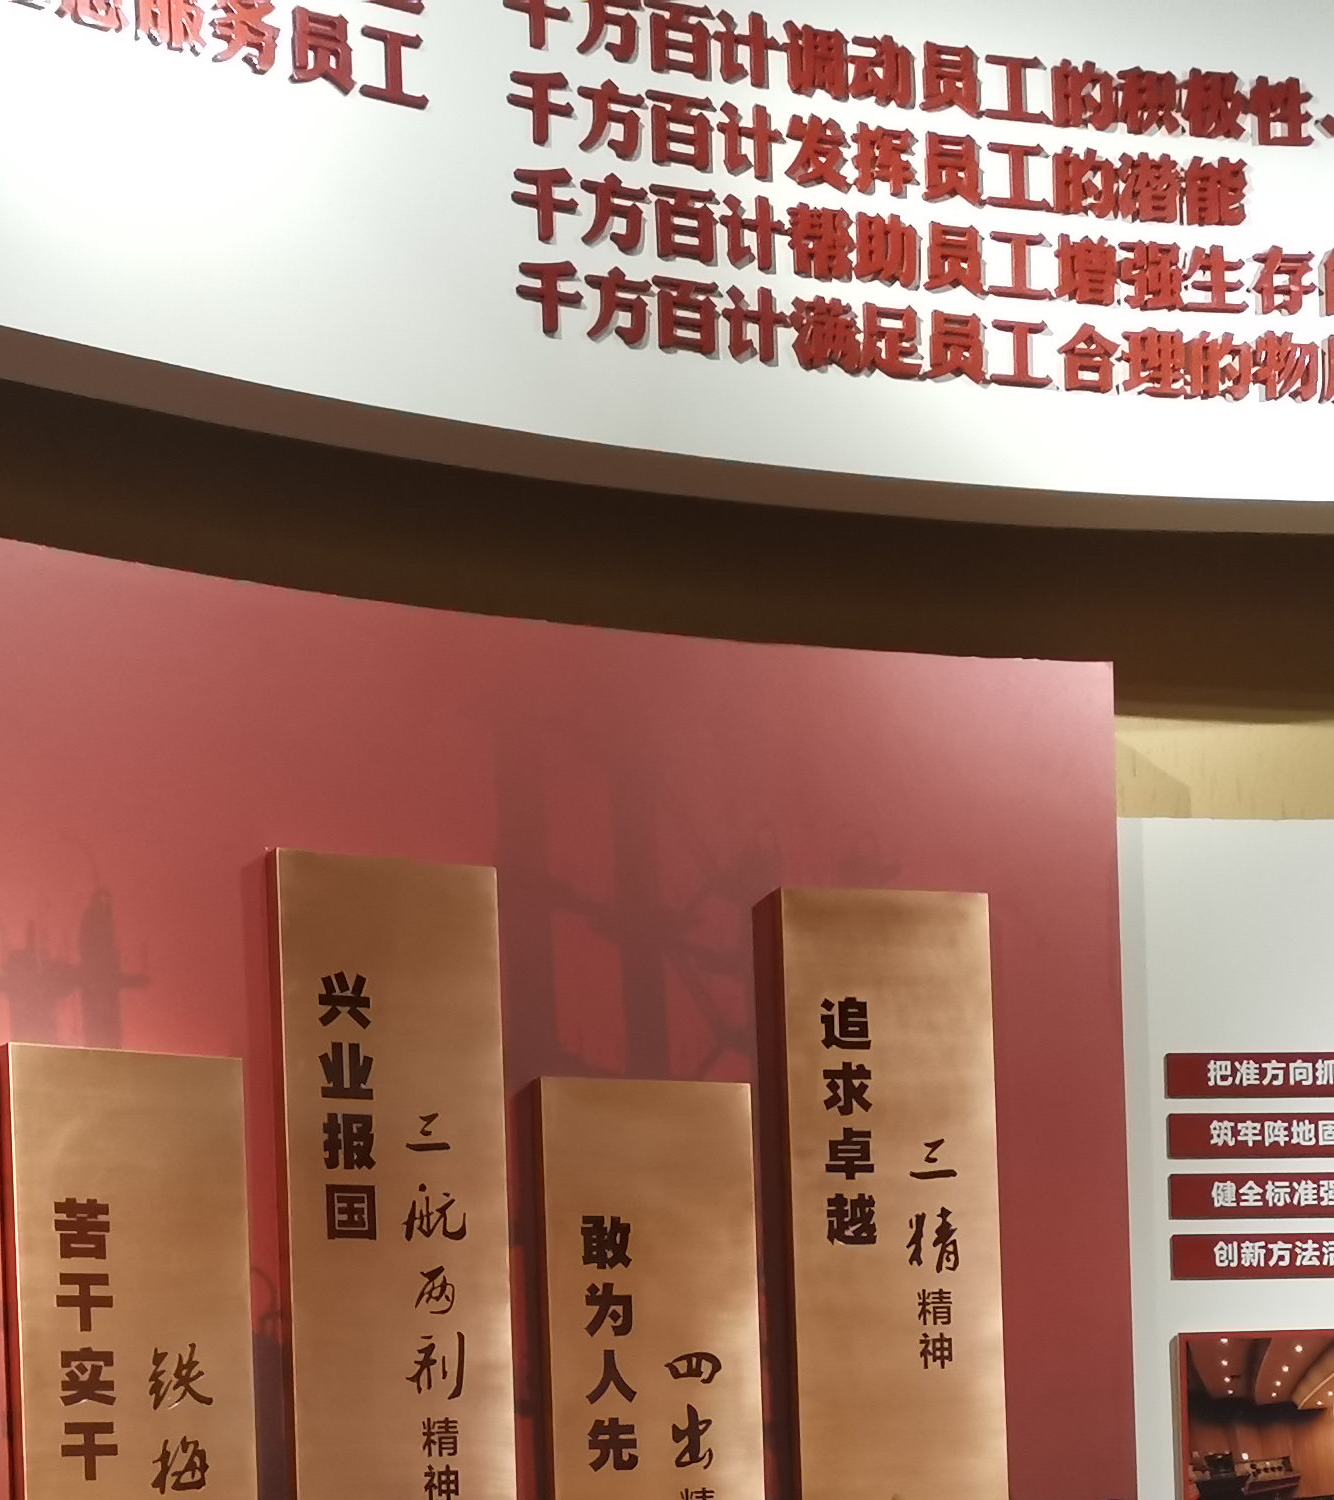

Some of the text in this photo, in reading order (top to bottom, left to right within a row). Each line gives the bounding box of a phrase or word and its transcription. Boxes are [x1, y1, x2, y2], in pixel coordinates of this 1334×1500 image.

[9, 0, 430, 111] 服务员工
[506, 70, 1247, 227] 千方百计发挥员工的潜能
[318, 971, 377, 1241] 兴业报国
[820, 996, 877, 1246] 追求卓越
[54, 1197, 118, 1481] 苦干实干
[581, 1215, 639, 1472] 敢为人先
[905, 1138, 960, 1370] 三精精神
